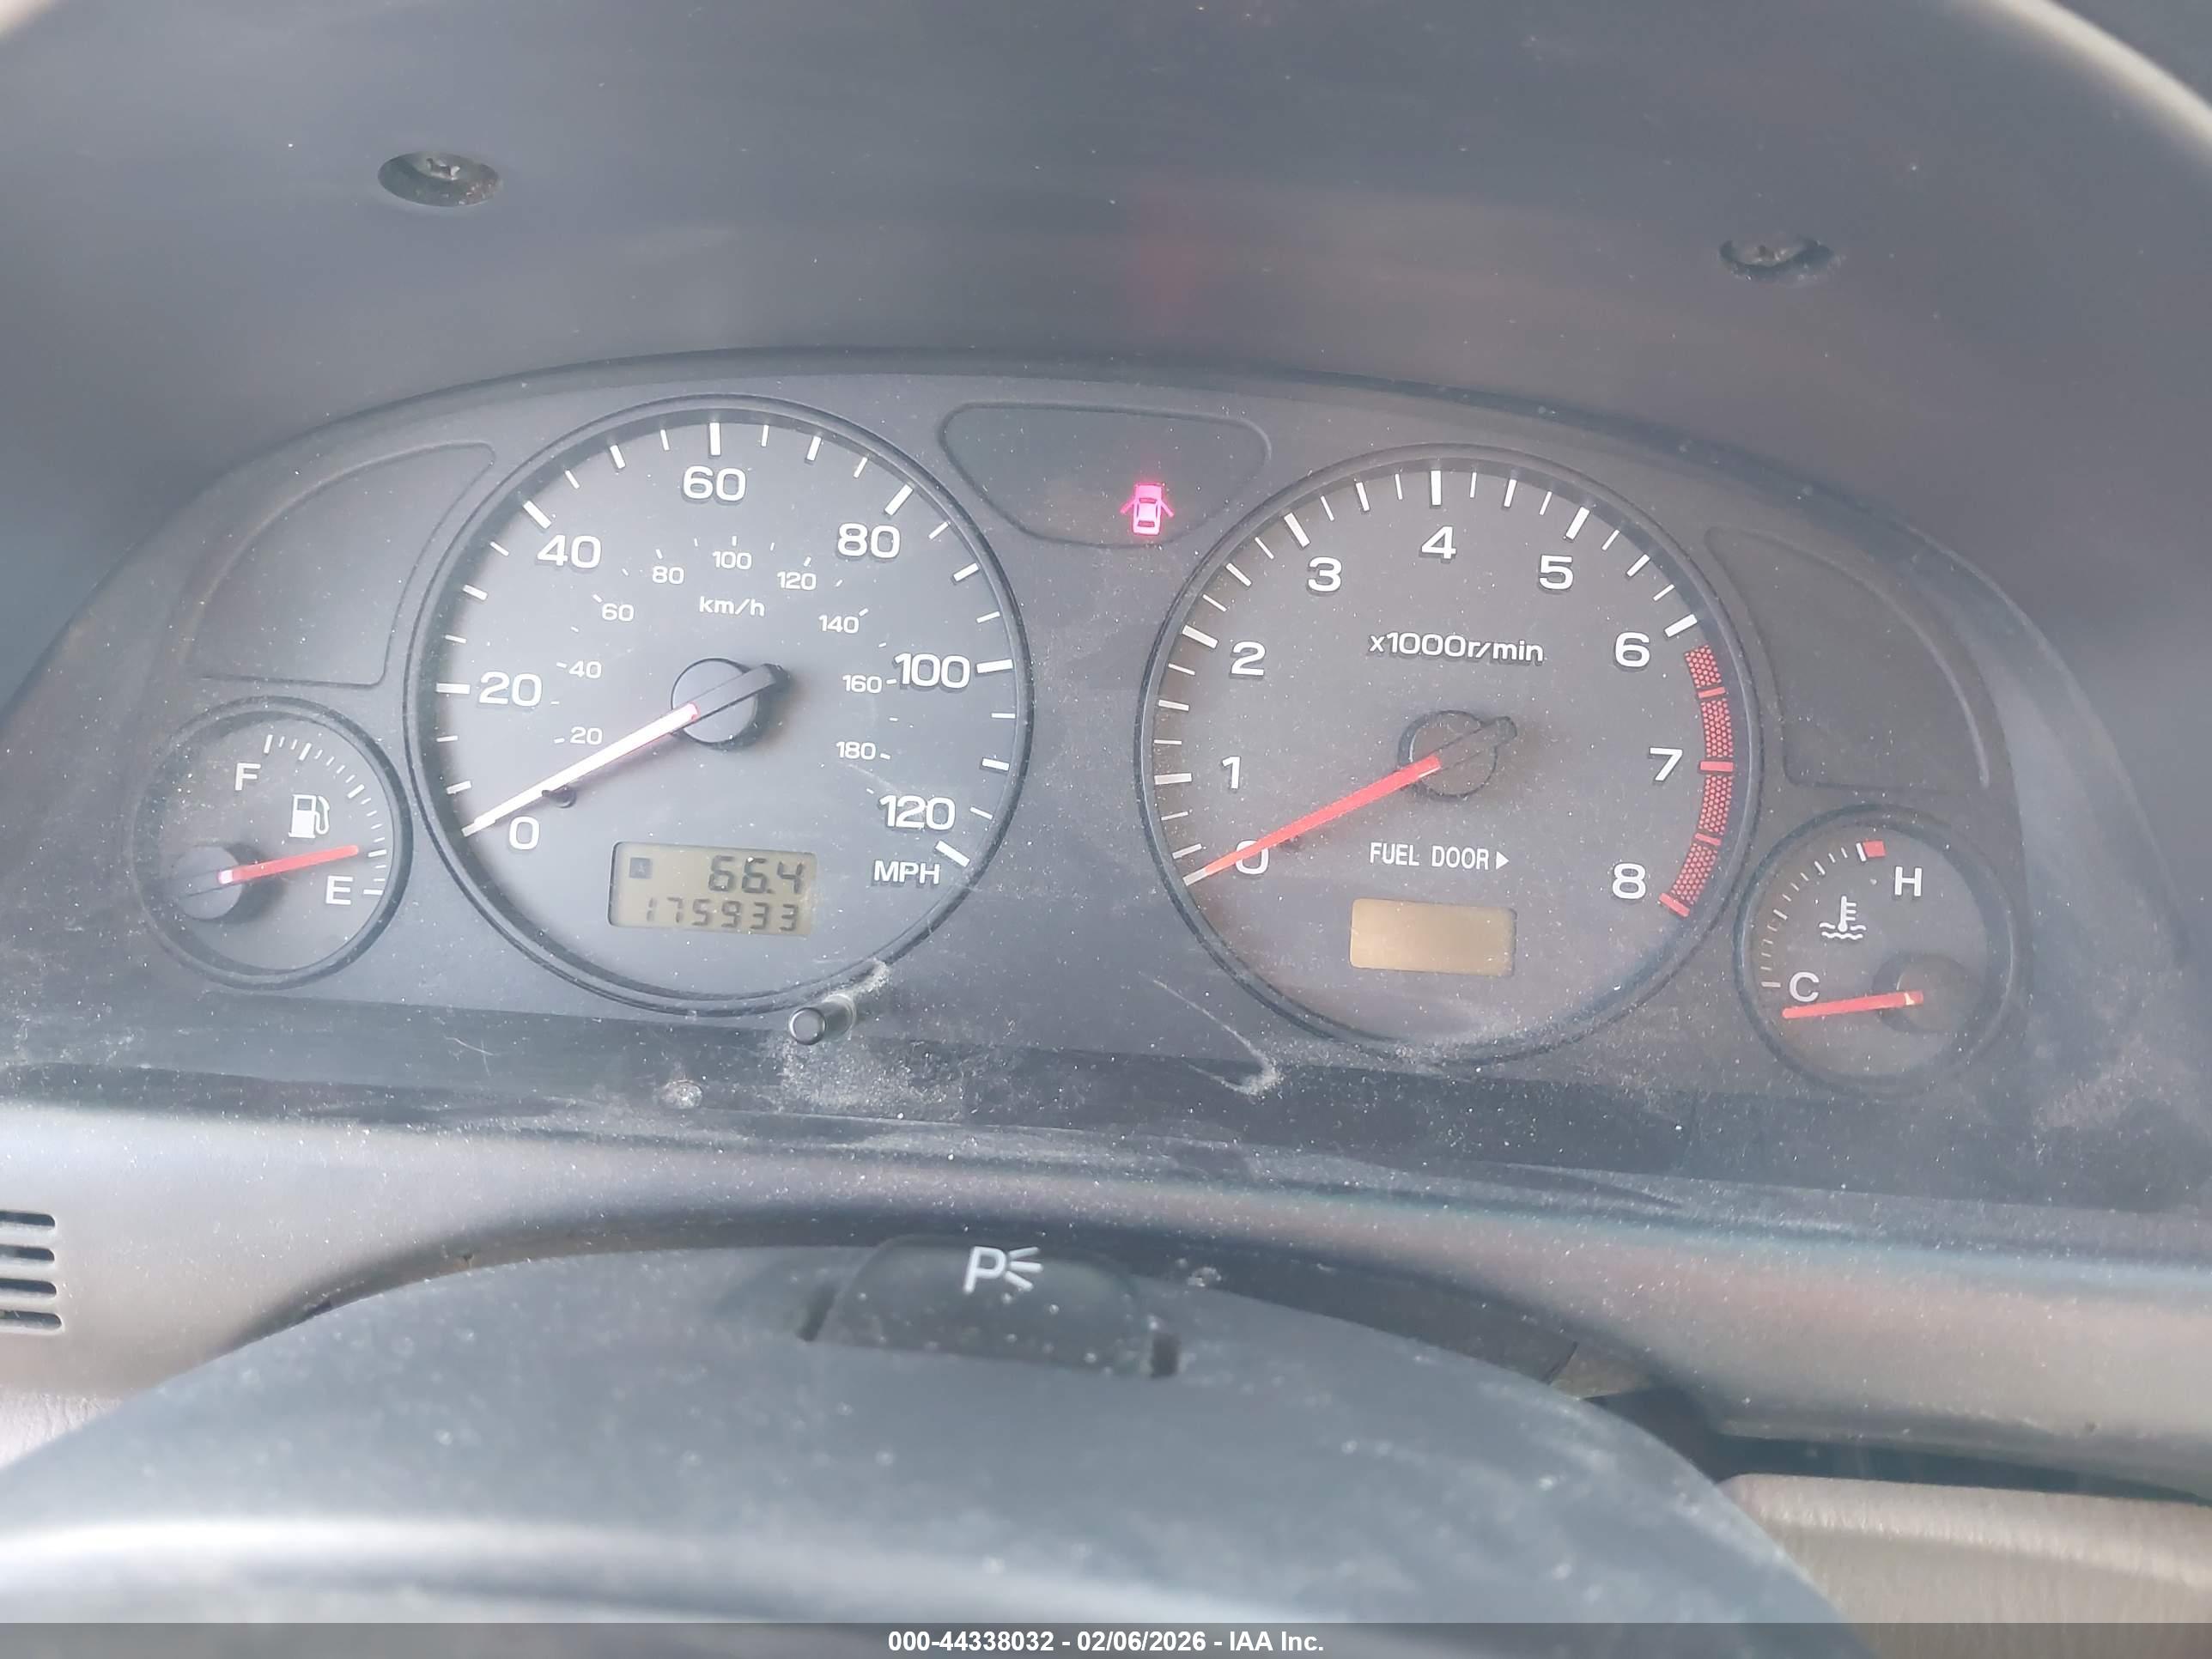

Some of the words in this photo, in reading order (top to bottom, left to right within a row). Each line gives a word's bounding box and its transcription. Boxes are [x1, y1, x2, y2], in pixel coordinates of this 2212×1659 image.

[684, 467, 747, 501] 60
[537, 535, 601, 568] 40
[837, 524, 900, 558] 80
[1422, 526, 1456, 559] 4
[652, 566, 684, 584] 80
[712, 551, 751, 570] 100
[1307, 557, 1341, 591] 3
[1539, 556, 1573, 589] 5
[777, 571, 816, 590] 120
[601, 603, 634, 622] 60
[699, 596, 764, 617] km/h
[819, 616, 859, 633] 140
[1231, 641, 1265, 677] 2
[1369, 631, 1544, 661] x1000r/min
[1614, 632, 1650, 668] 6
[569, 661, 601, 678] 40
[842, 674, 882, 693] 160
[895, 653, 969, 688] 100
[479, 673, 542, 706] 20
[570, 727, 602, 744] 20
[836, 742, 876, 760] 180
[234, 763, 261, 791] F
[1221, 757, 1241, 789] 1
[1649, 748, 1682, 781] 7
[879, 795, 954, 830] 120
[508, 816, 540, 849] 0
[1236, 840, 1269, 875] 0
[1370, 842, 1419, 866] FUEL
[1431, 845, 1489, 870] DOOR
[708, 854, 805, 895] 66.4
[874, 861, 939, 884] MPH
[1613, 863, 1646, 900] 8
[1894, 866, 1923, 896] H
[325, 875, 353, 905] E
[647, 896, 799, 931] 175933
[1789, 971, 1820, 1002] C
[963, 1246, 1007, 1295] P
